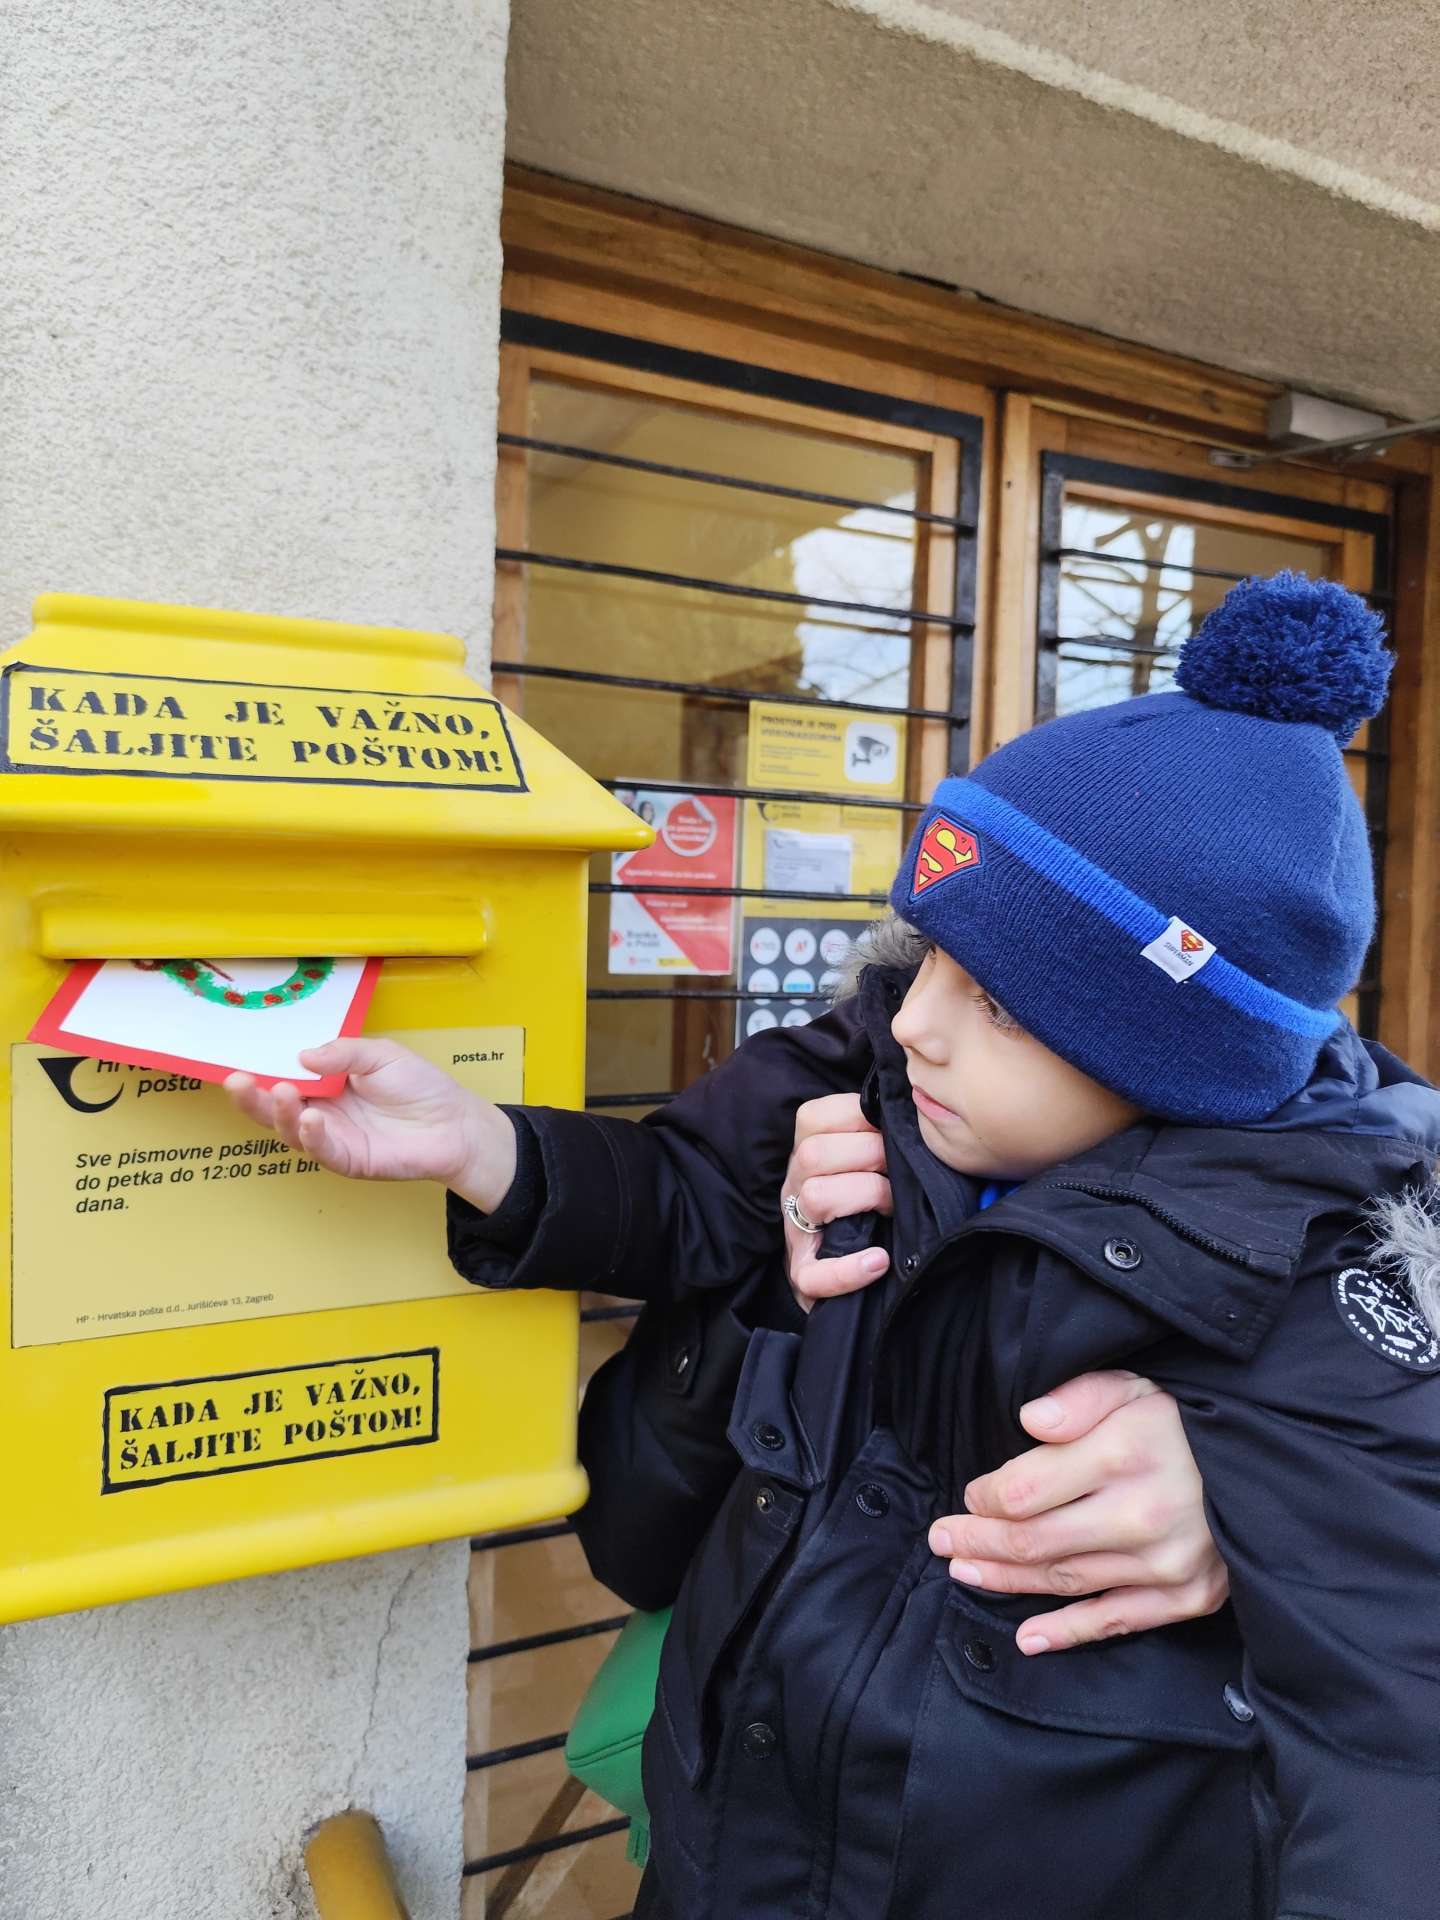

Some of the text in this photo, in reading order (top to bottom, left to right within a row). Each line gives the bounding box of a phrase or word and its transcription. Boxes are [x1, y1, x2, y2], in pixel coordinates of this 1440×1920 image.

[28, 686, 490, 739] KADA JE VAŽNO,
[29, 718, 504, 773] ŠALJITE POŠTOM!
[453, 1051, 505, 1065] posta.hr
[137, 1074, 202, 1098] pošta
[75, 1153, 112, 1168] Sve
[118, 1146, 213, 1168] pismovne
[75, 1174, 101, 1191] do
[107, 1170, 163, 1192] petka
[169, 1167, 194, 1183] do
[201, 1163, 252, 1180] 12:00
[257, 1158, 291, 1176] sati
[75, 1196, 130, 1214] dana.
[97, 1309, 137, 1321] Hrvatska
[139, 1306, 164, 1318] pošta
[119, 1368, 421, 1433] KADA JE VAŽNO,
[120, 1405, 423, 1471] ŠALJITE POŠTOM!
